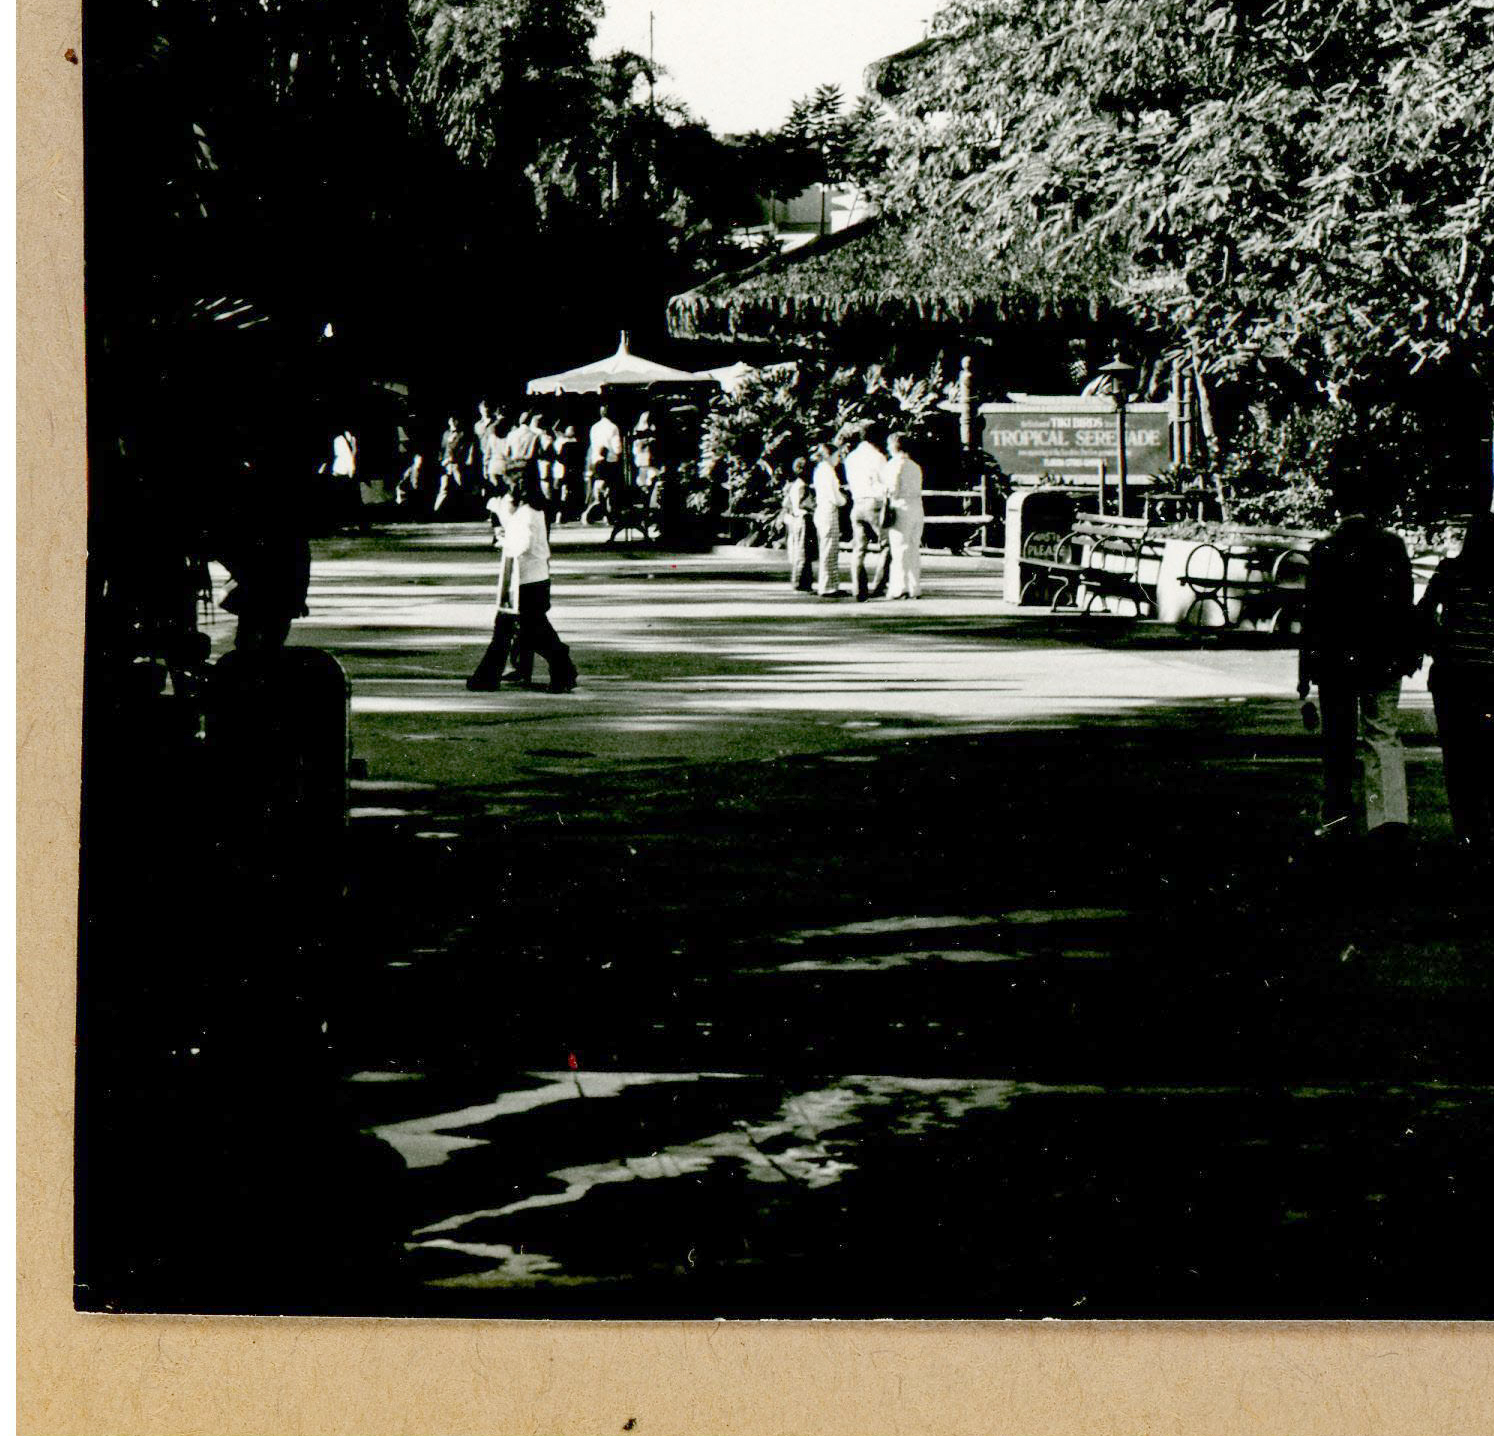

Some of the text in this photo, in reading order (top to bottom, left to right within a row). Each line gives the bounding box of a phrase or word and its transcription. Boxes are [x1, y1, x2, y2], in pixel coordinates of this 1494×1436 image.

[1050, 417, 1071, 428] TIKI
[989, 429, 1161, 447] TROPICAL SEREADE
